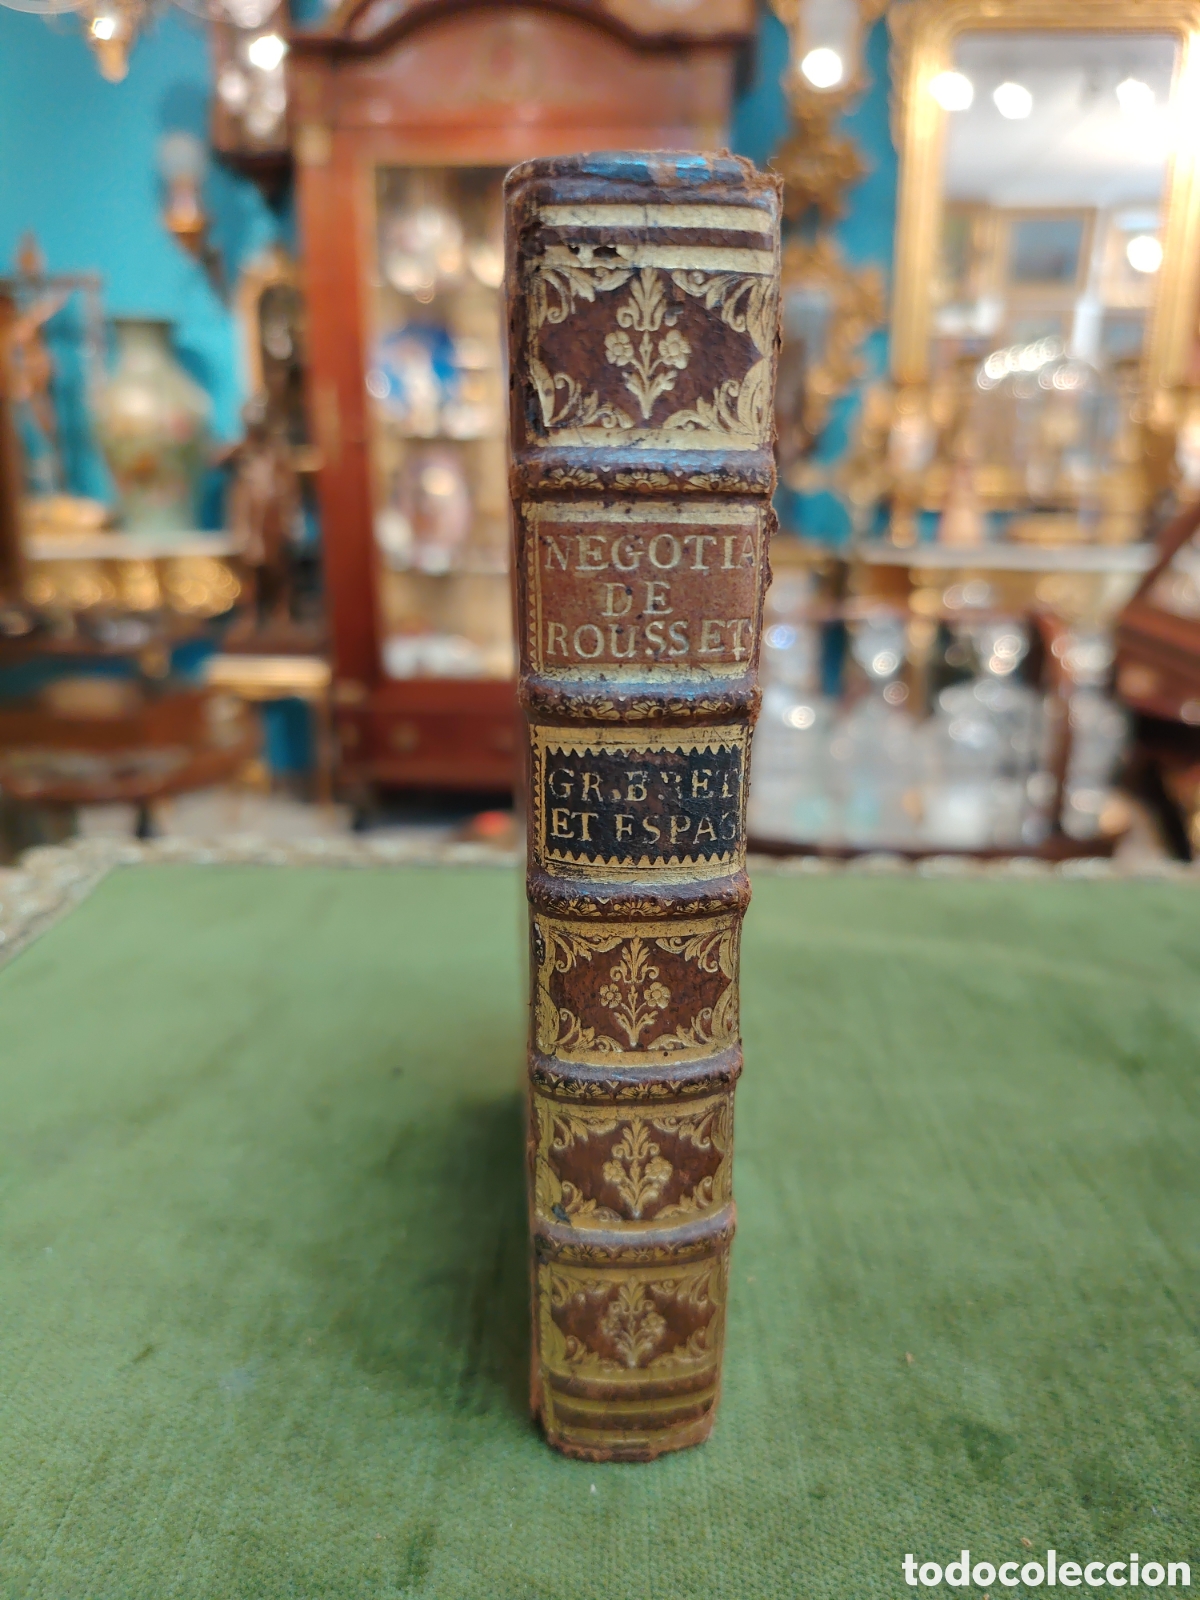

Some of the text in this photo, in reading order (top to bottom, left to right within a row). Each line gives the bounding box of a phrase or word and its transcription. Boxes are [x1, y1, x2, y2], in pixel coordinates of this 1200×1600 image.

[545, 534, 756, 571] NEGOTIA
[602, 581, 673, 616] DE
[546, 619, 753, 660] ROUSSET
[551, 807, 598, 842] ET
